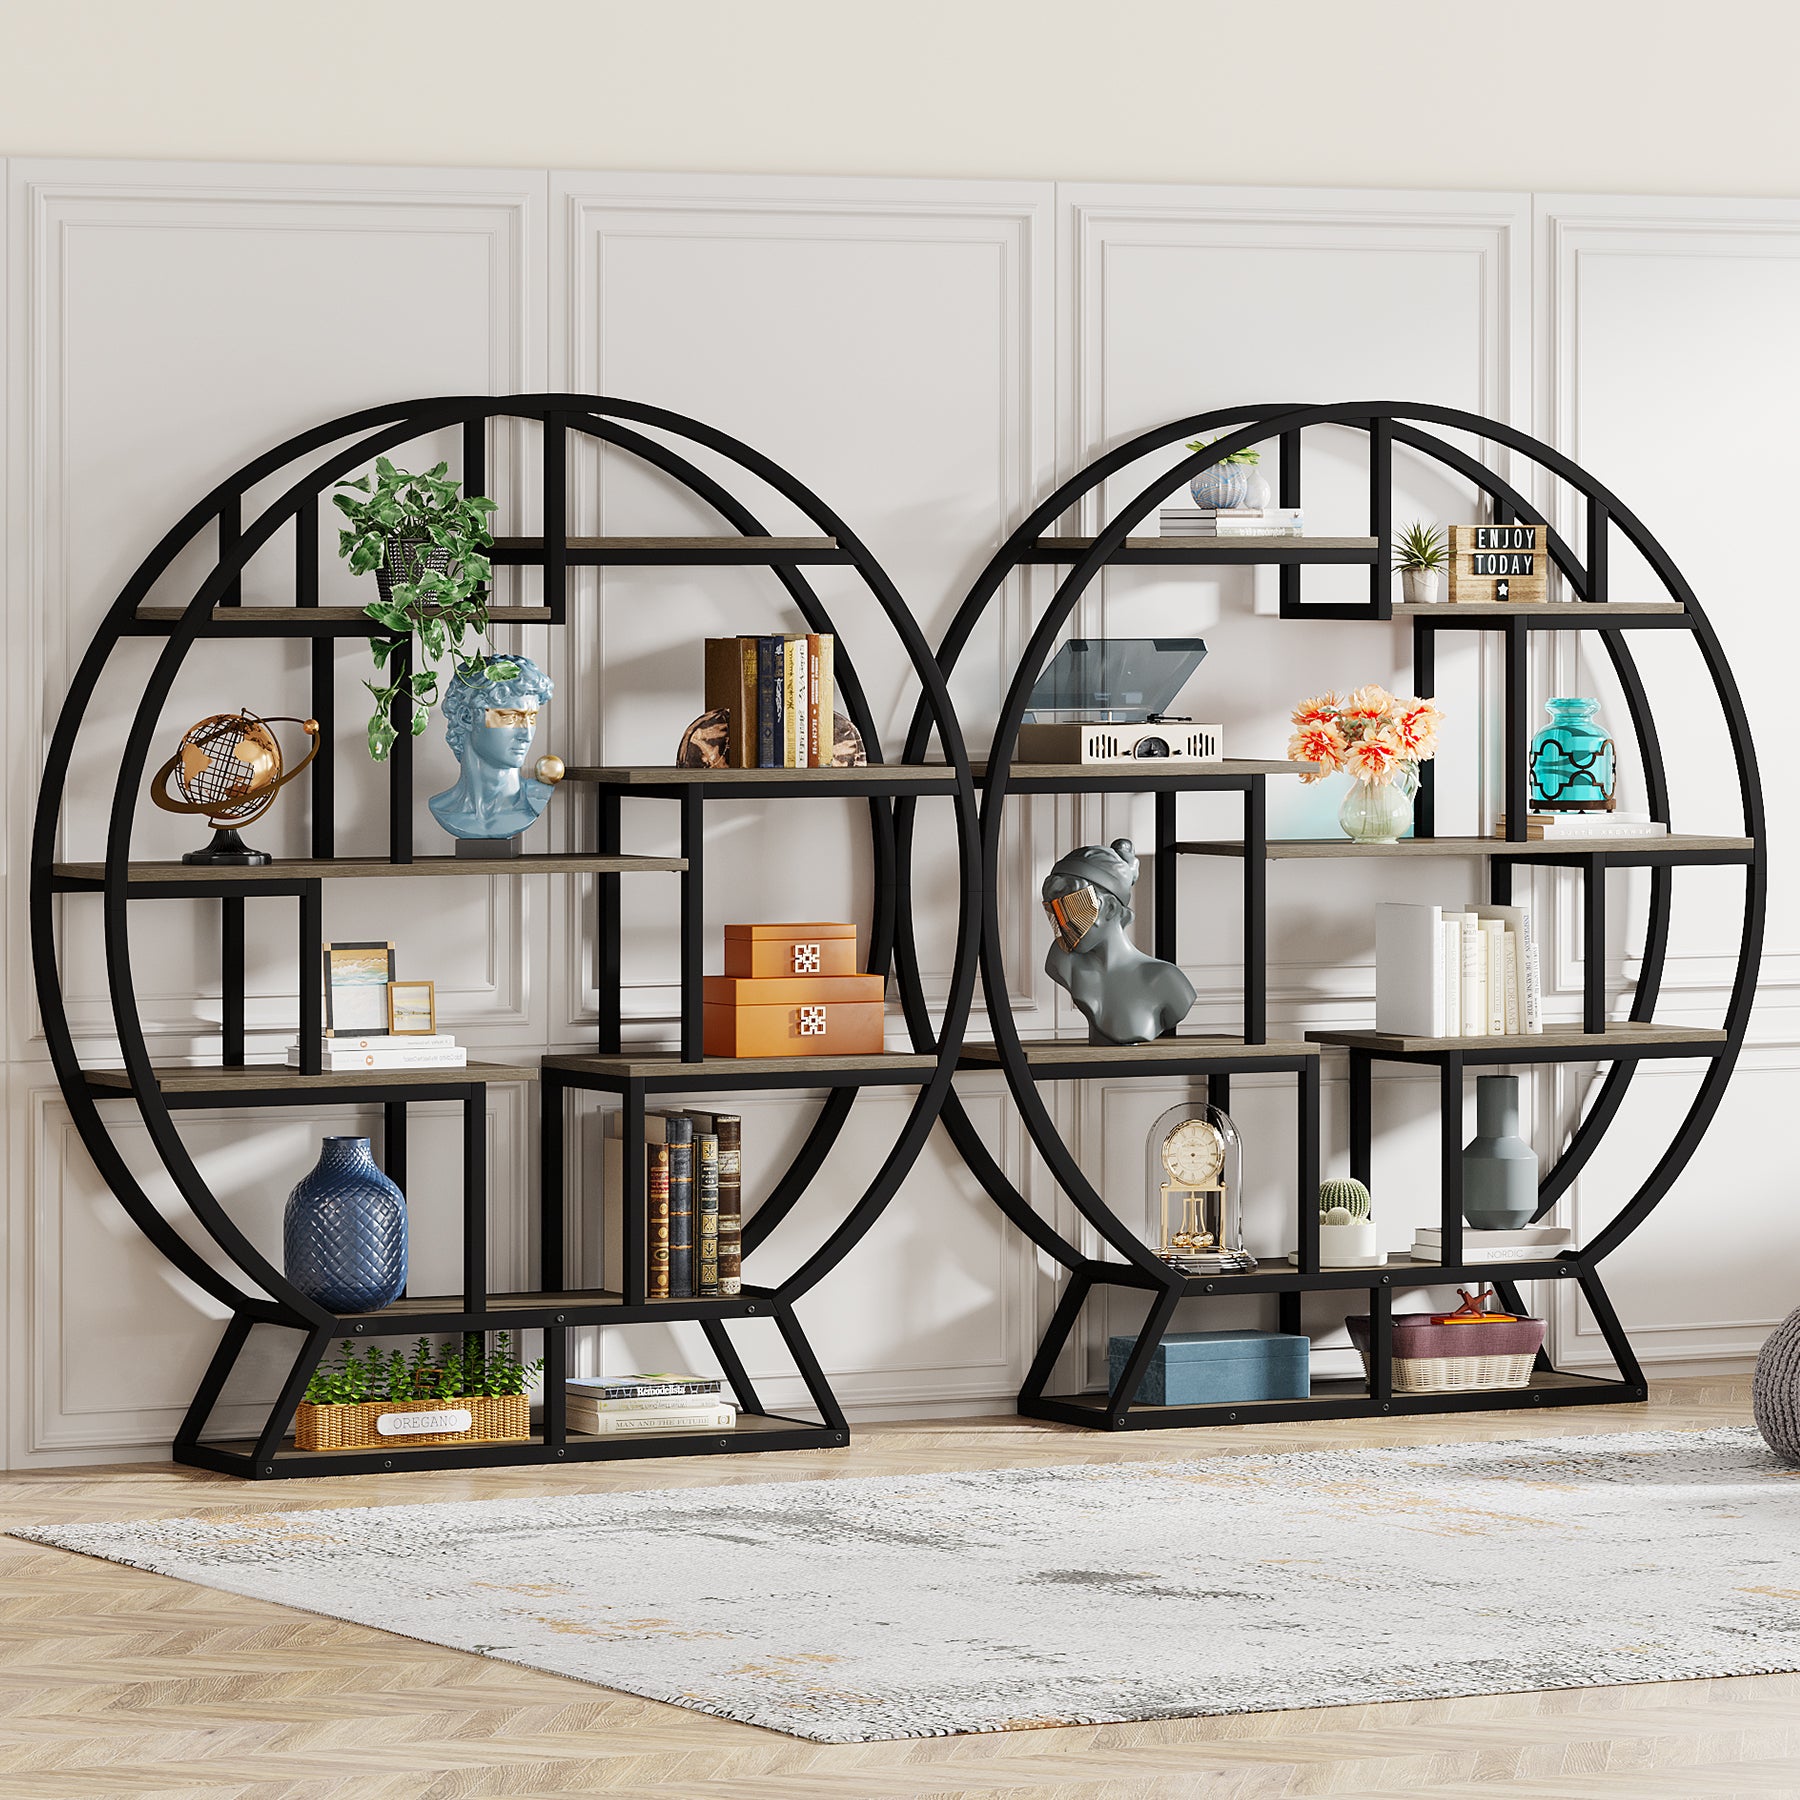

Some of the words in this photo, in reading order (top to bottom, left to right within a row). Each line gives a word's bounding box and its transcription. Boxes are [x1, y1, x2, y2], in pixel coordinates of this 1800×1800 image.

[1478, 528, 1535, 549] ENJOY
[1475, 554, 1532, 575] TODAY
[1505, 949, 1516, 986] ARCTIC
[1507, 986, 1517, 1026] DREAMS
[1486, 1249, 1524, 1259] NORDIC
[392, 1414, 458, 1431] OREGANO
